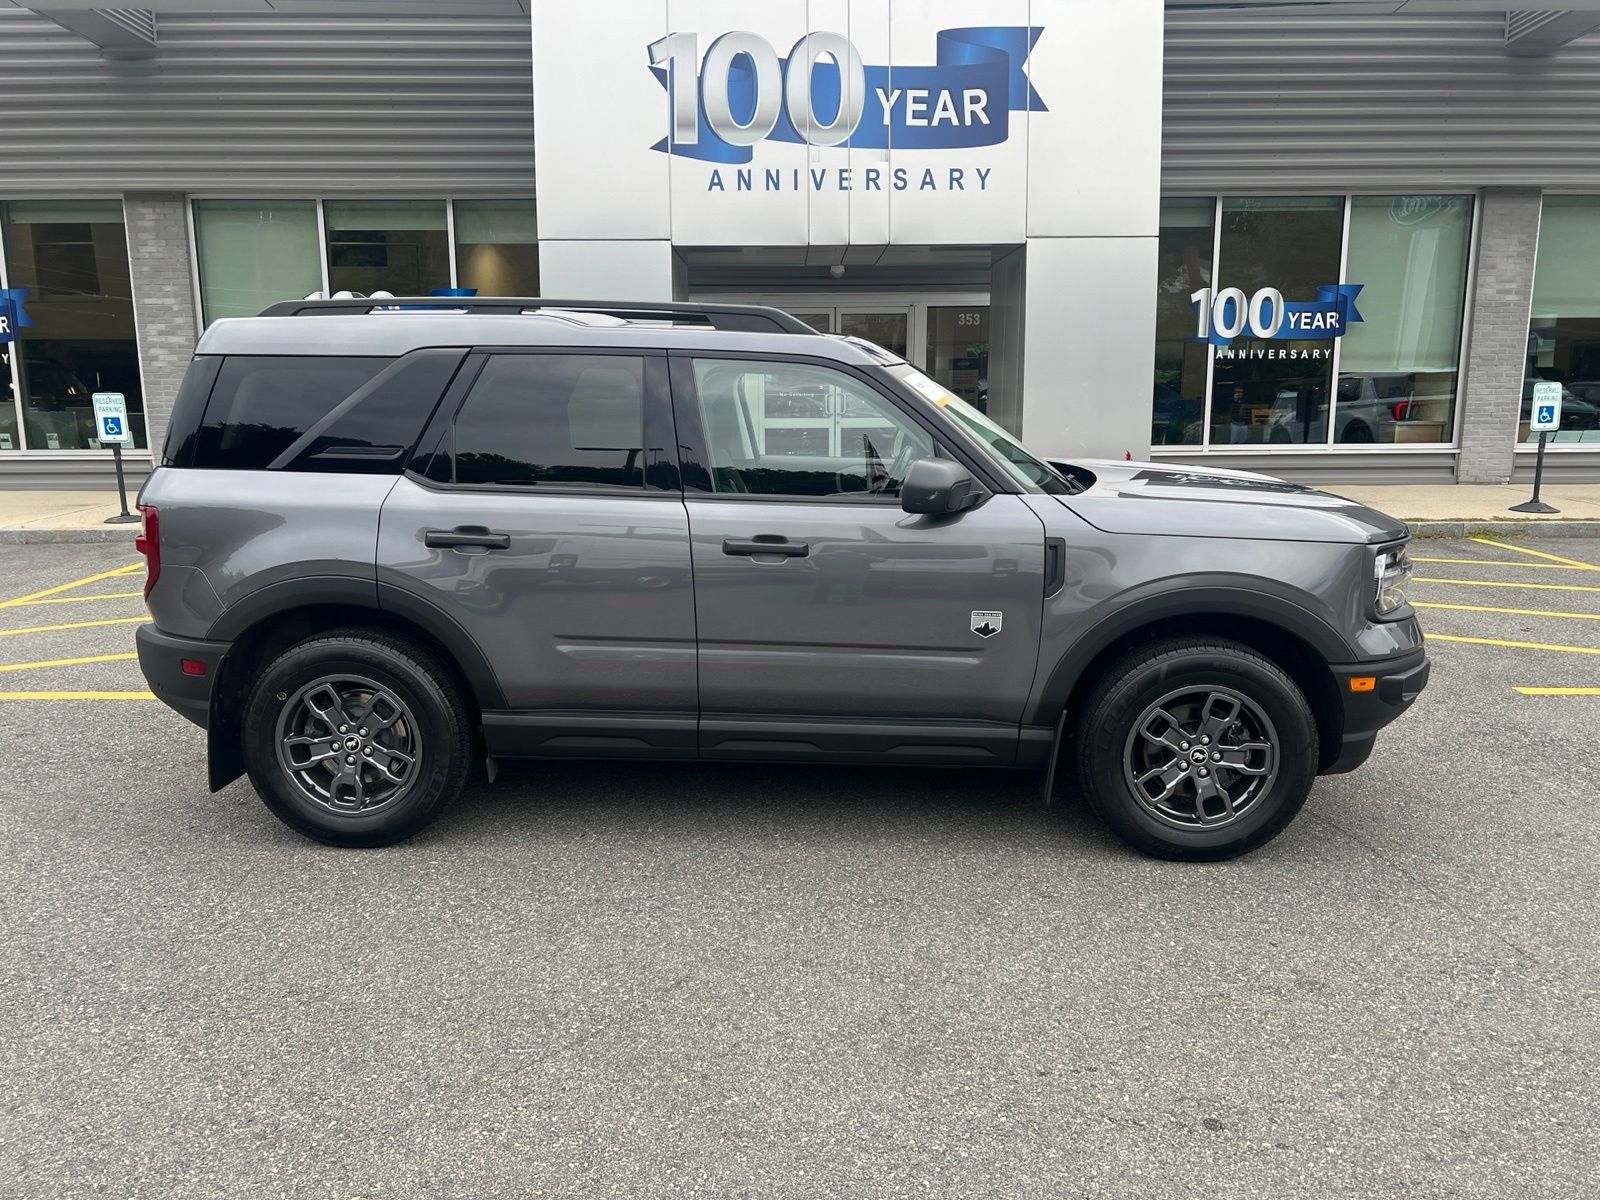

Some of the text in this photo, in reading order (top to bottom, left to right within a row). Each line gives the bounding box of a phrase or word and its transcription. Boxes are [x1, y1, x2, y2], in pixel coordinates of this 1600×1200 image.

[648, 31, 991, 146] 100 YEAR
[708, 167, 992, 191] ANNIVERSARY
[958, 313, 981, 326] 353
[1190, 287, 1340, 339] 100 YEAR
[1215, 349, 1332, 360] ANNIVERSARY
